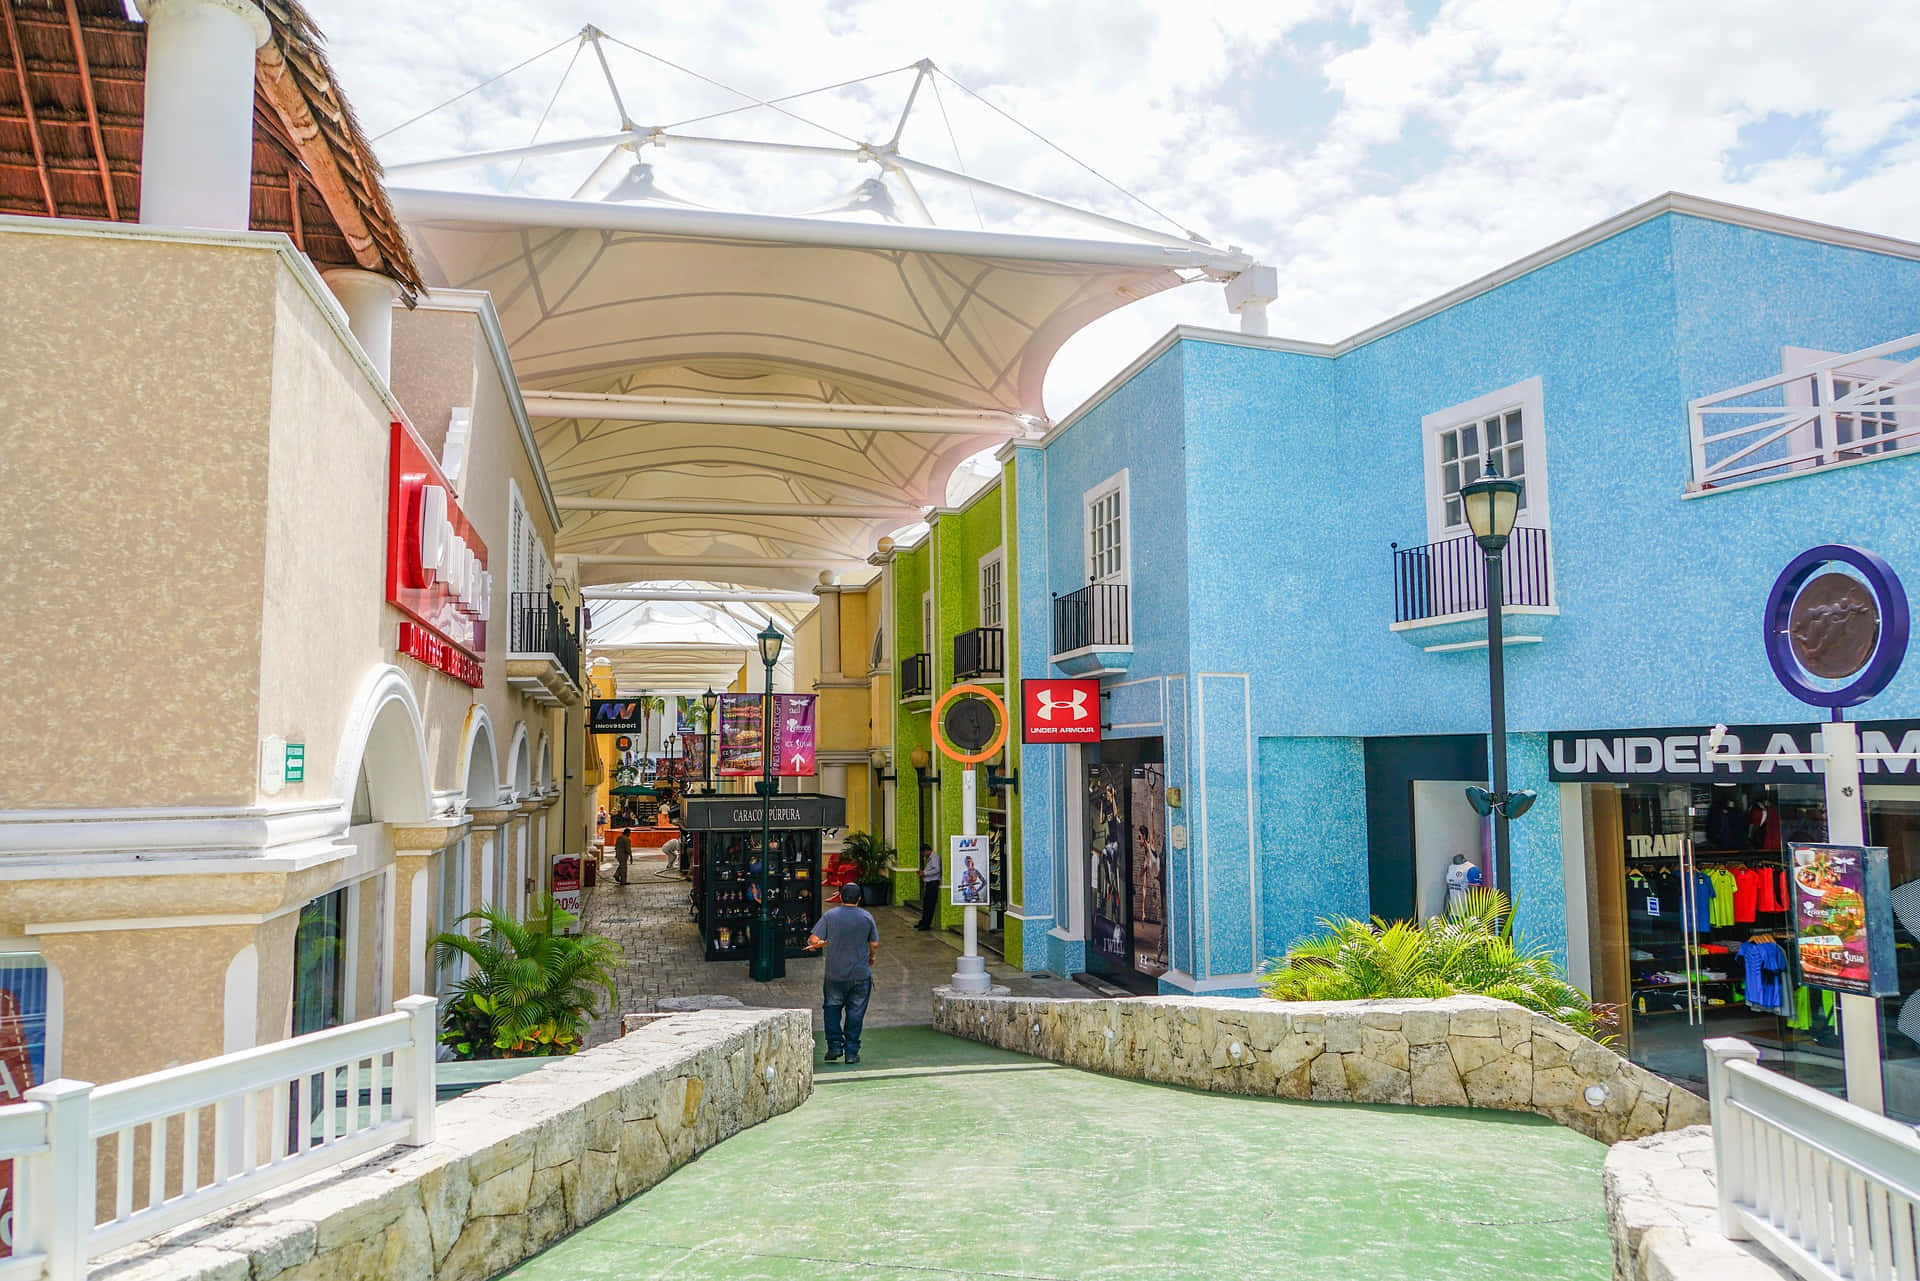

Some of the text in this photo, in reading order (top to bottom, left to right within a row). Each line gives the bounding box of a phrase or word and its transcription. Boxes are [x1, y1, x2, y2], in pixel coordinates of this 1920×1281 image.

[1553, 735, 1742, 773] UNDER
[733, 804, 801, 822] CARACO PÚRPURA
